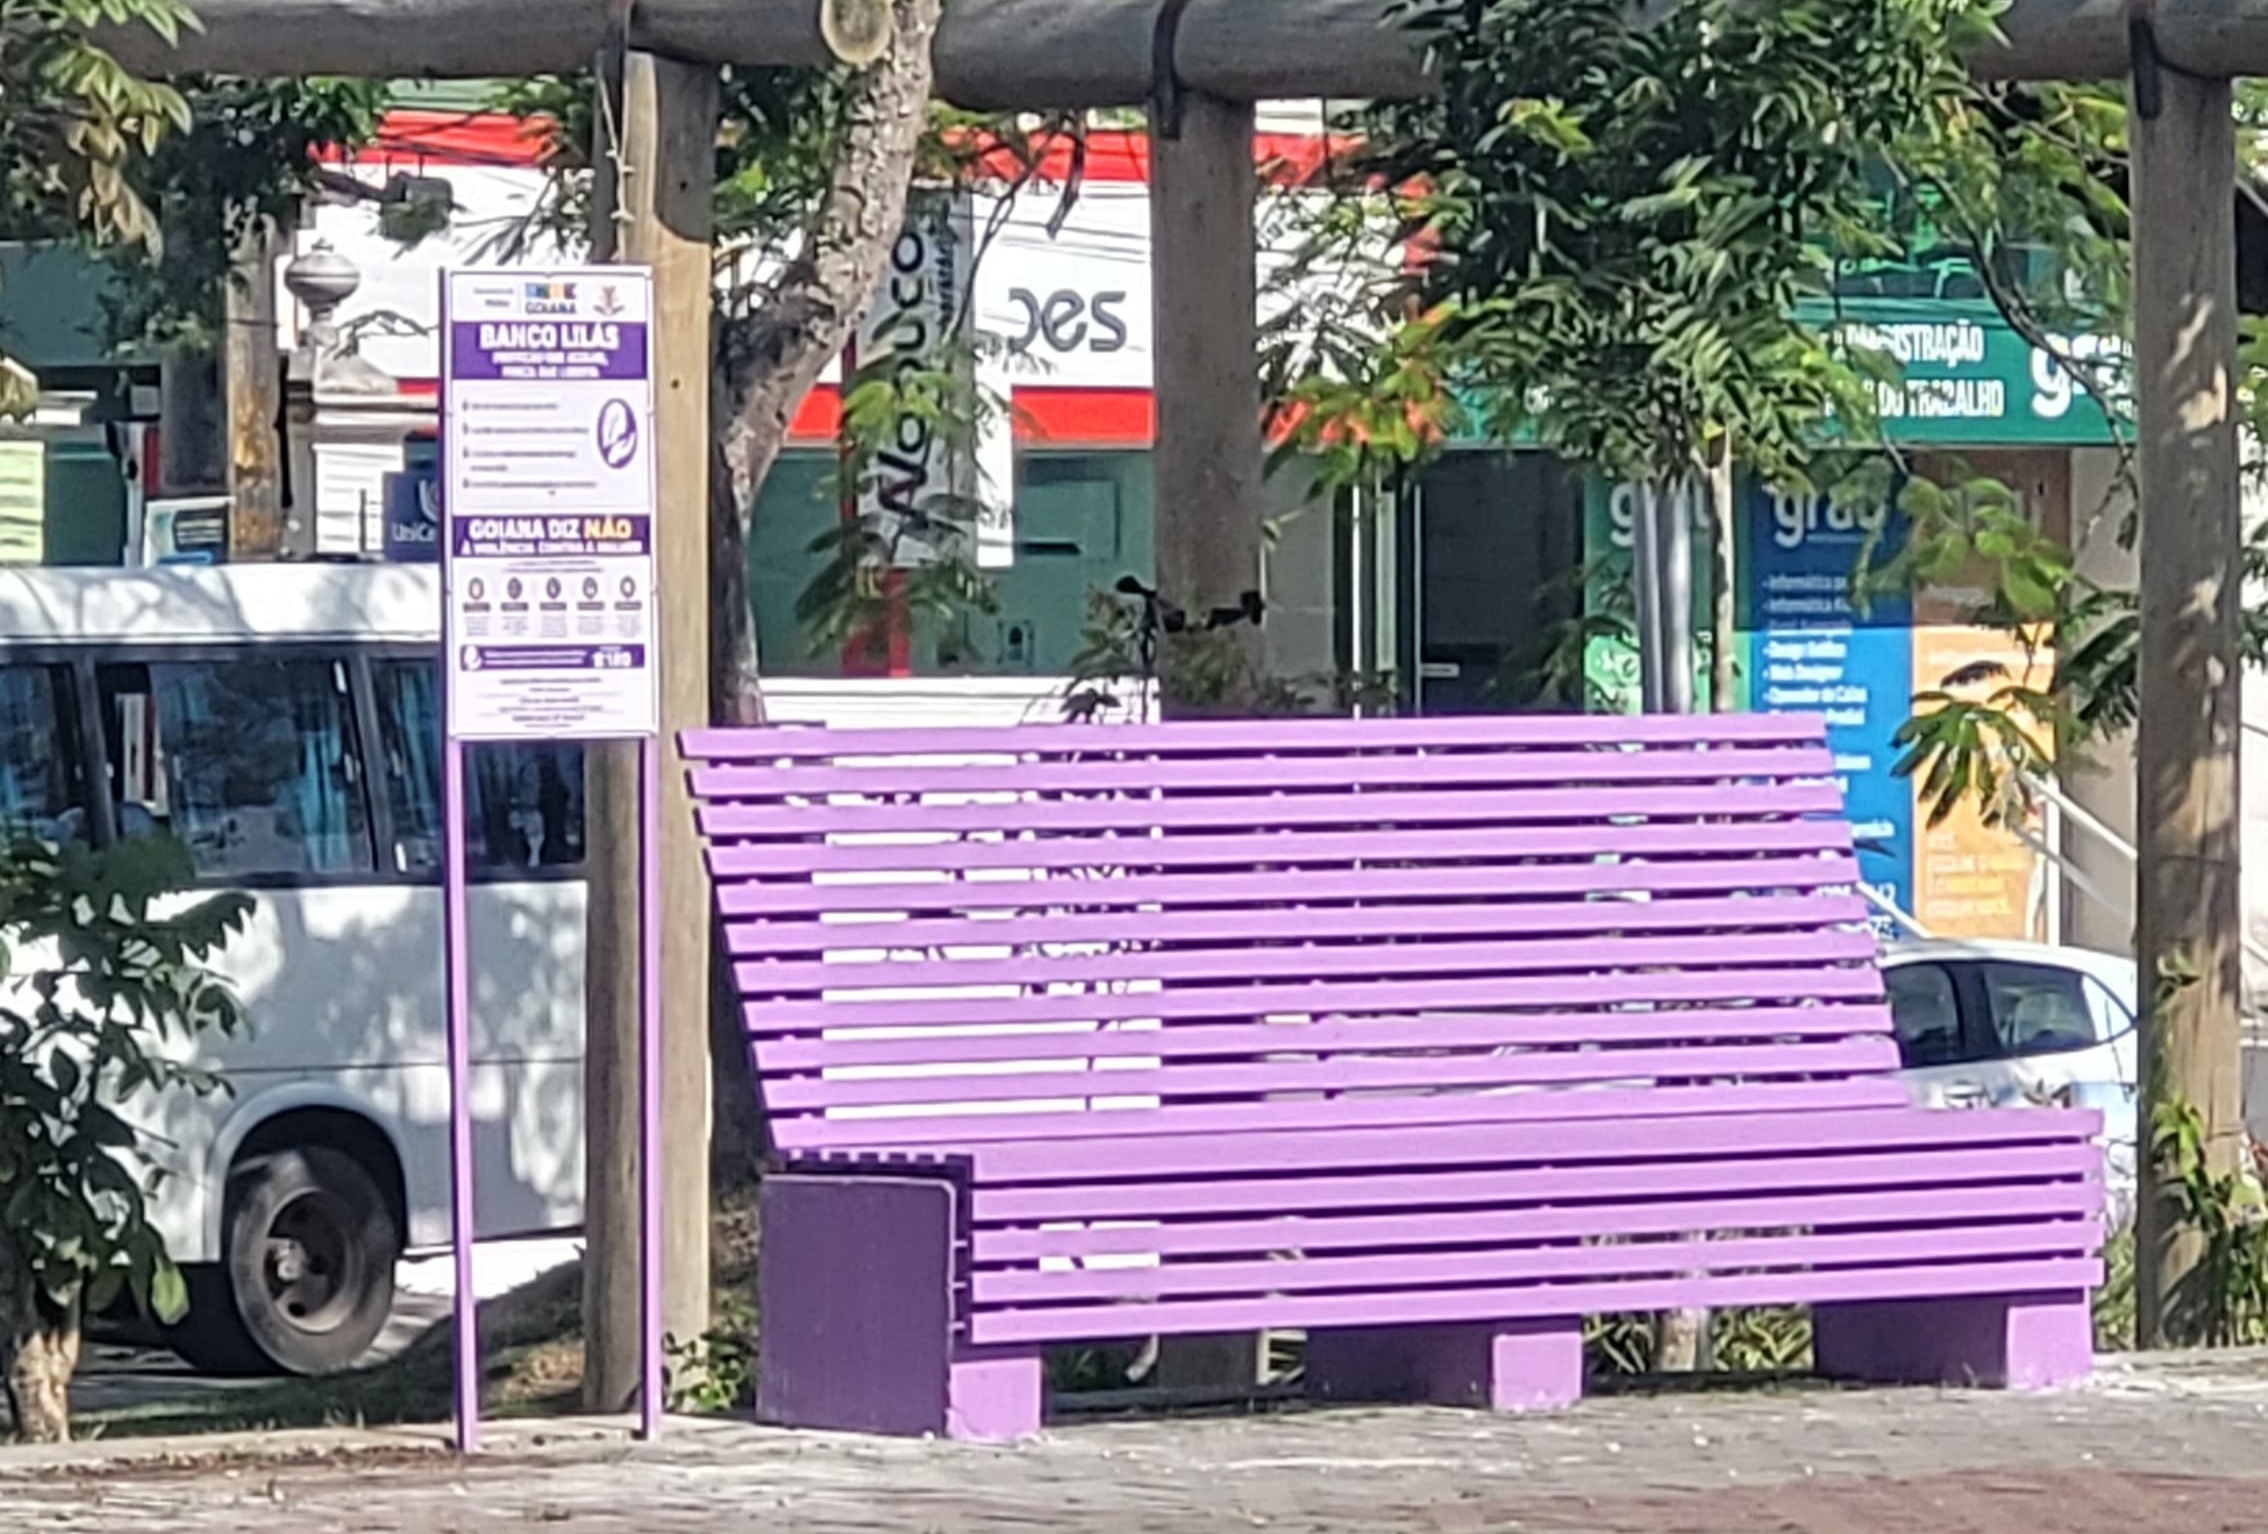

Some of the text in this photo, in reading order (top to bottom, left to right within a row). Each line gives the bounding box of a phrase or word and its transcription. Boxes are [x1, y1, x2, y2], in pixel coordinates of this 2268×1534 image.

[479, 320, 620, 350] BANCO LILÁS
[1906, 379, 2004, 418] TRABALHO
[468, 515, 633, 540] GOIANA DIZ NÃO
